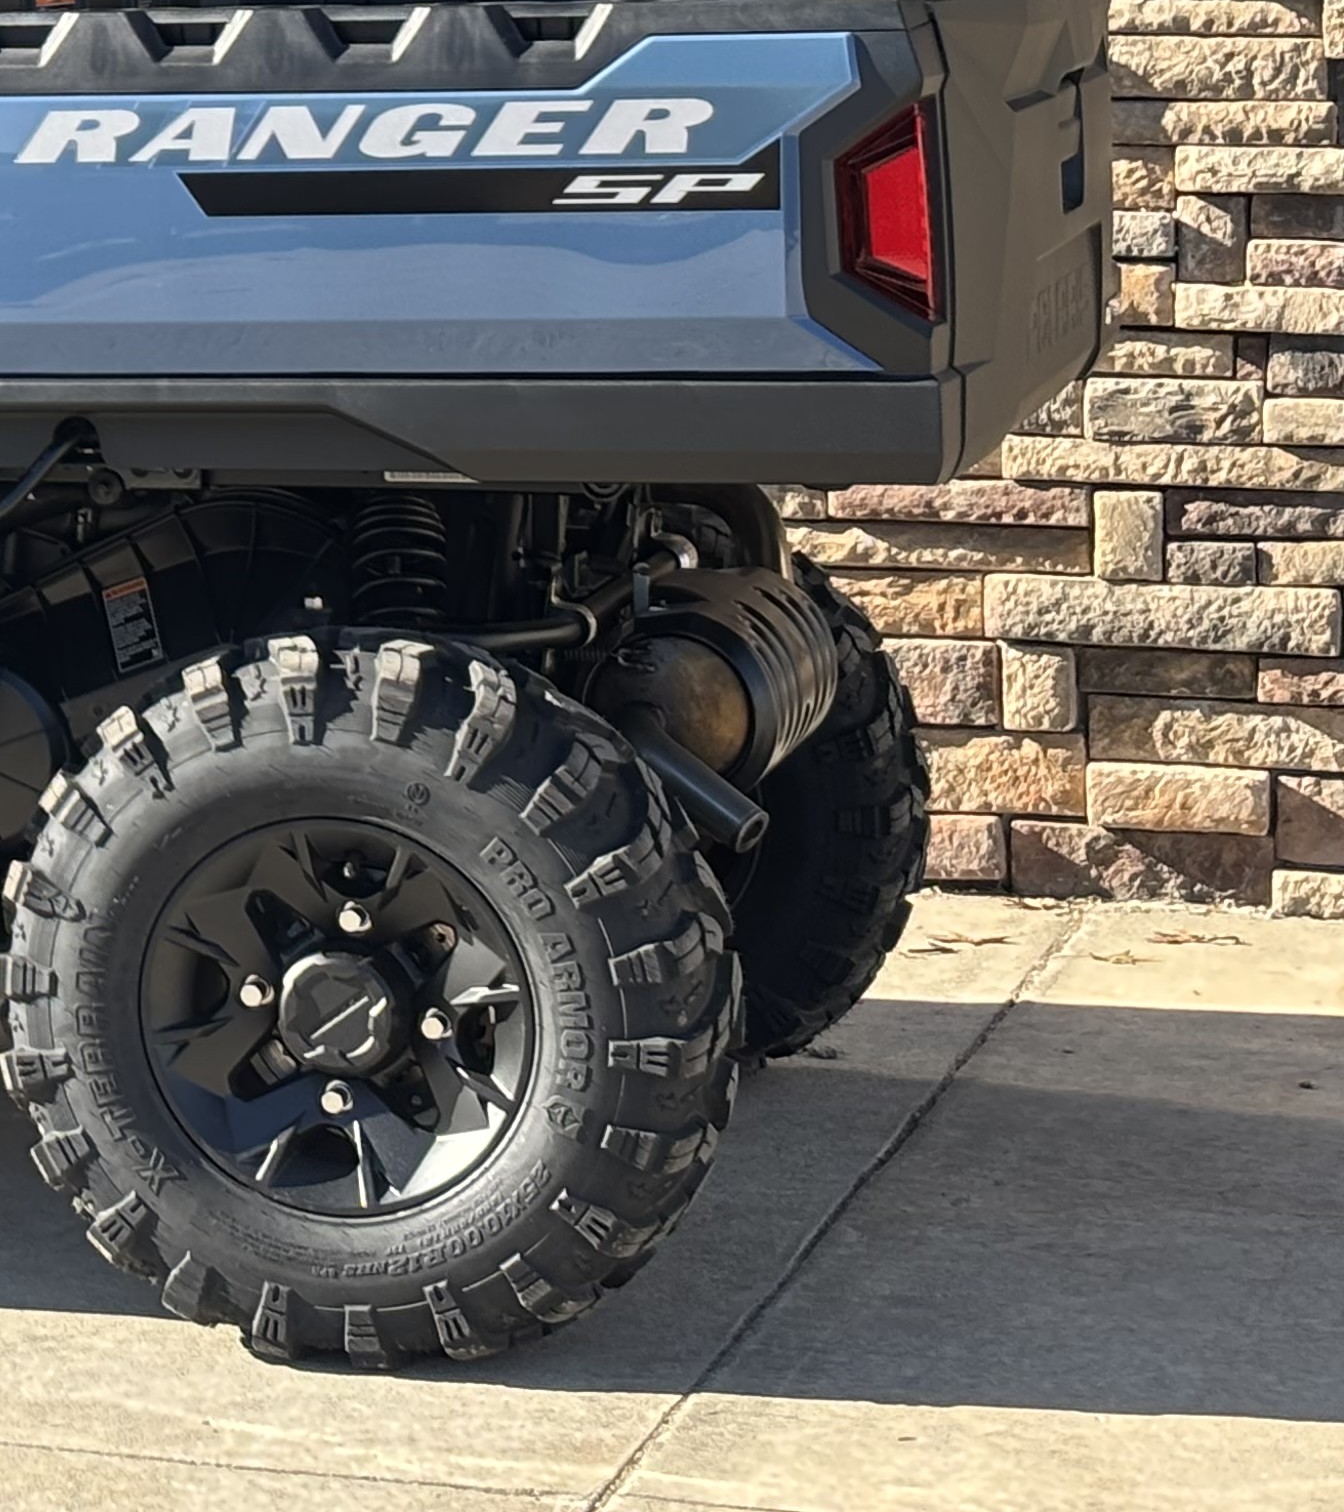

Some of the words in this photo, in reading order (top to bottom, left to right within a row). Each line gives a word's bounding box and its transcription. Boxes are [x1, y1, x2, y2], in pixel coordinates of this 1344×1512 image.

[13, 97, 714, 165] RANGER
[552, 172, 766, 206] SP
[480, 836, 556, 921] PRO
[540, 932, 592, 1093] ARMOR
